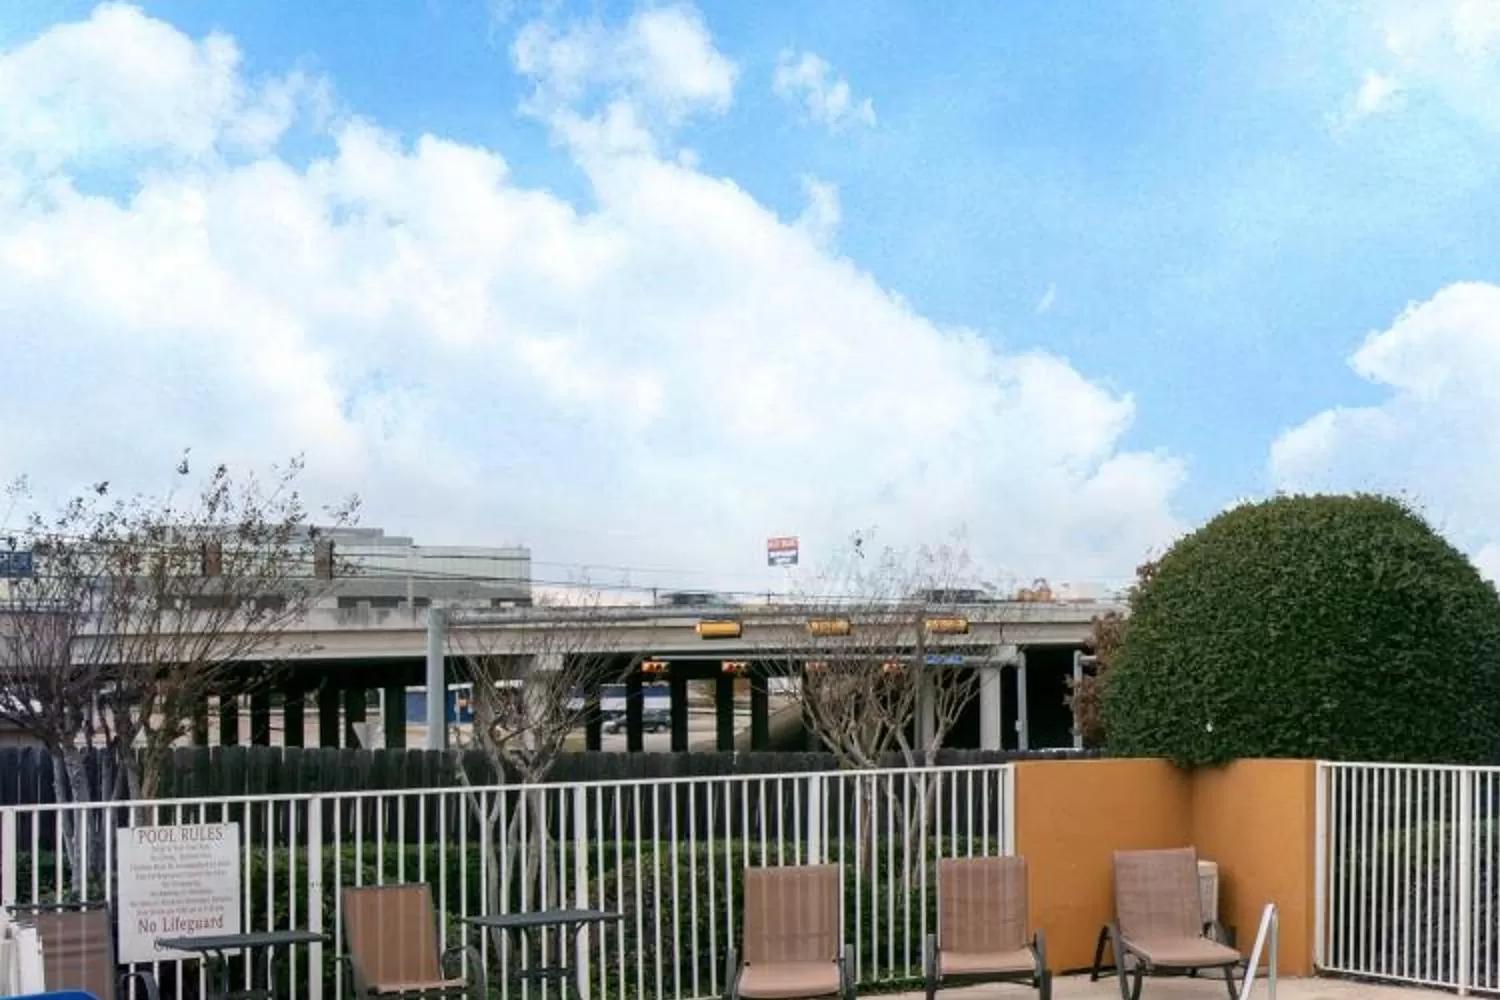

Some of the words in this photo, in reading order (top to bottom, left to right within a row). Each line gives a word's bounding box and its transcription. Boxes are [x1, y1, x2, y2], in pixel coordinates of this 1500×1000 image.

[138, 829, 176, 844] POOL
[181, 826, 223, 841] RULES
[138, 918, 157, 934] No
[163, 915, 224, 933] Lifeguard
